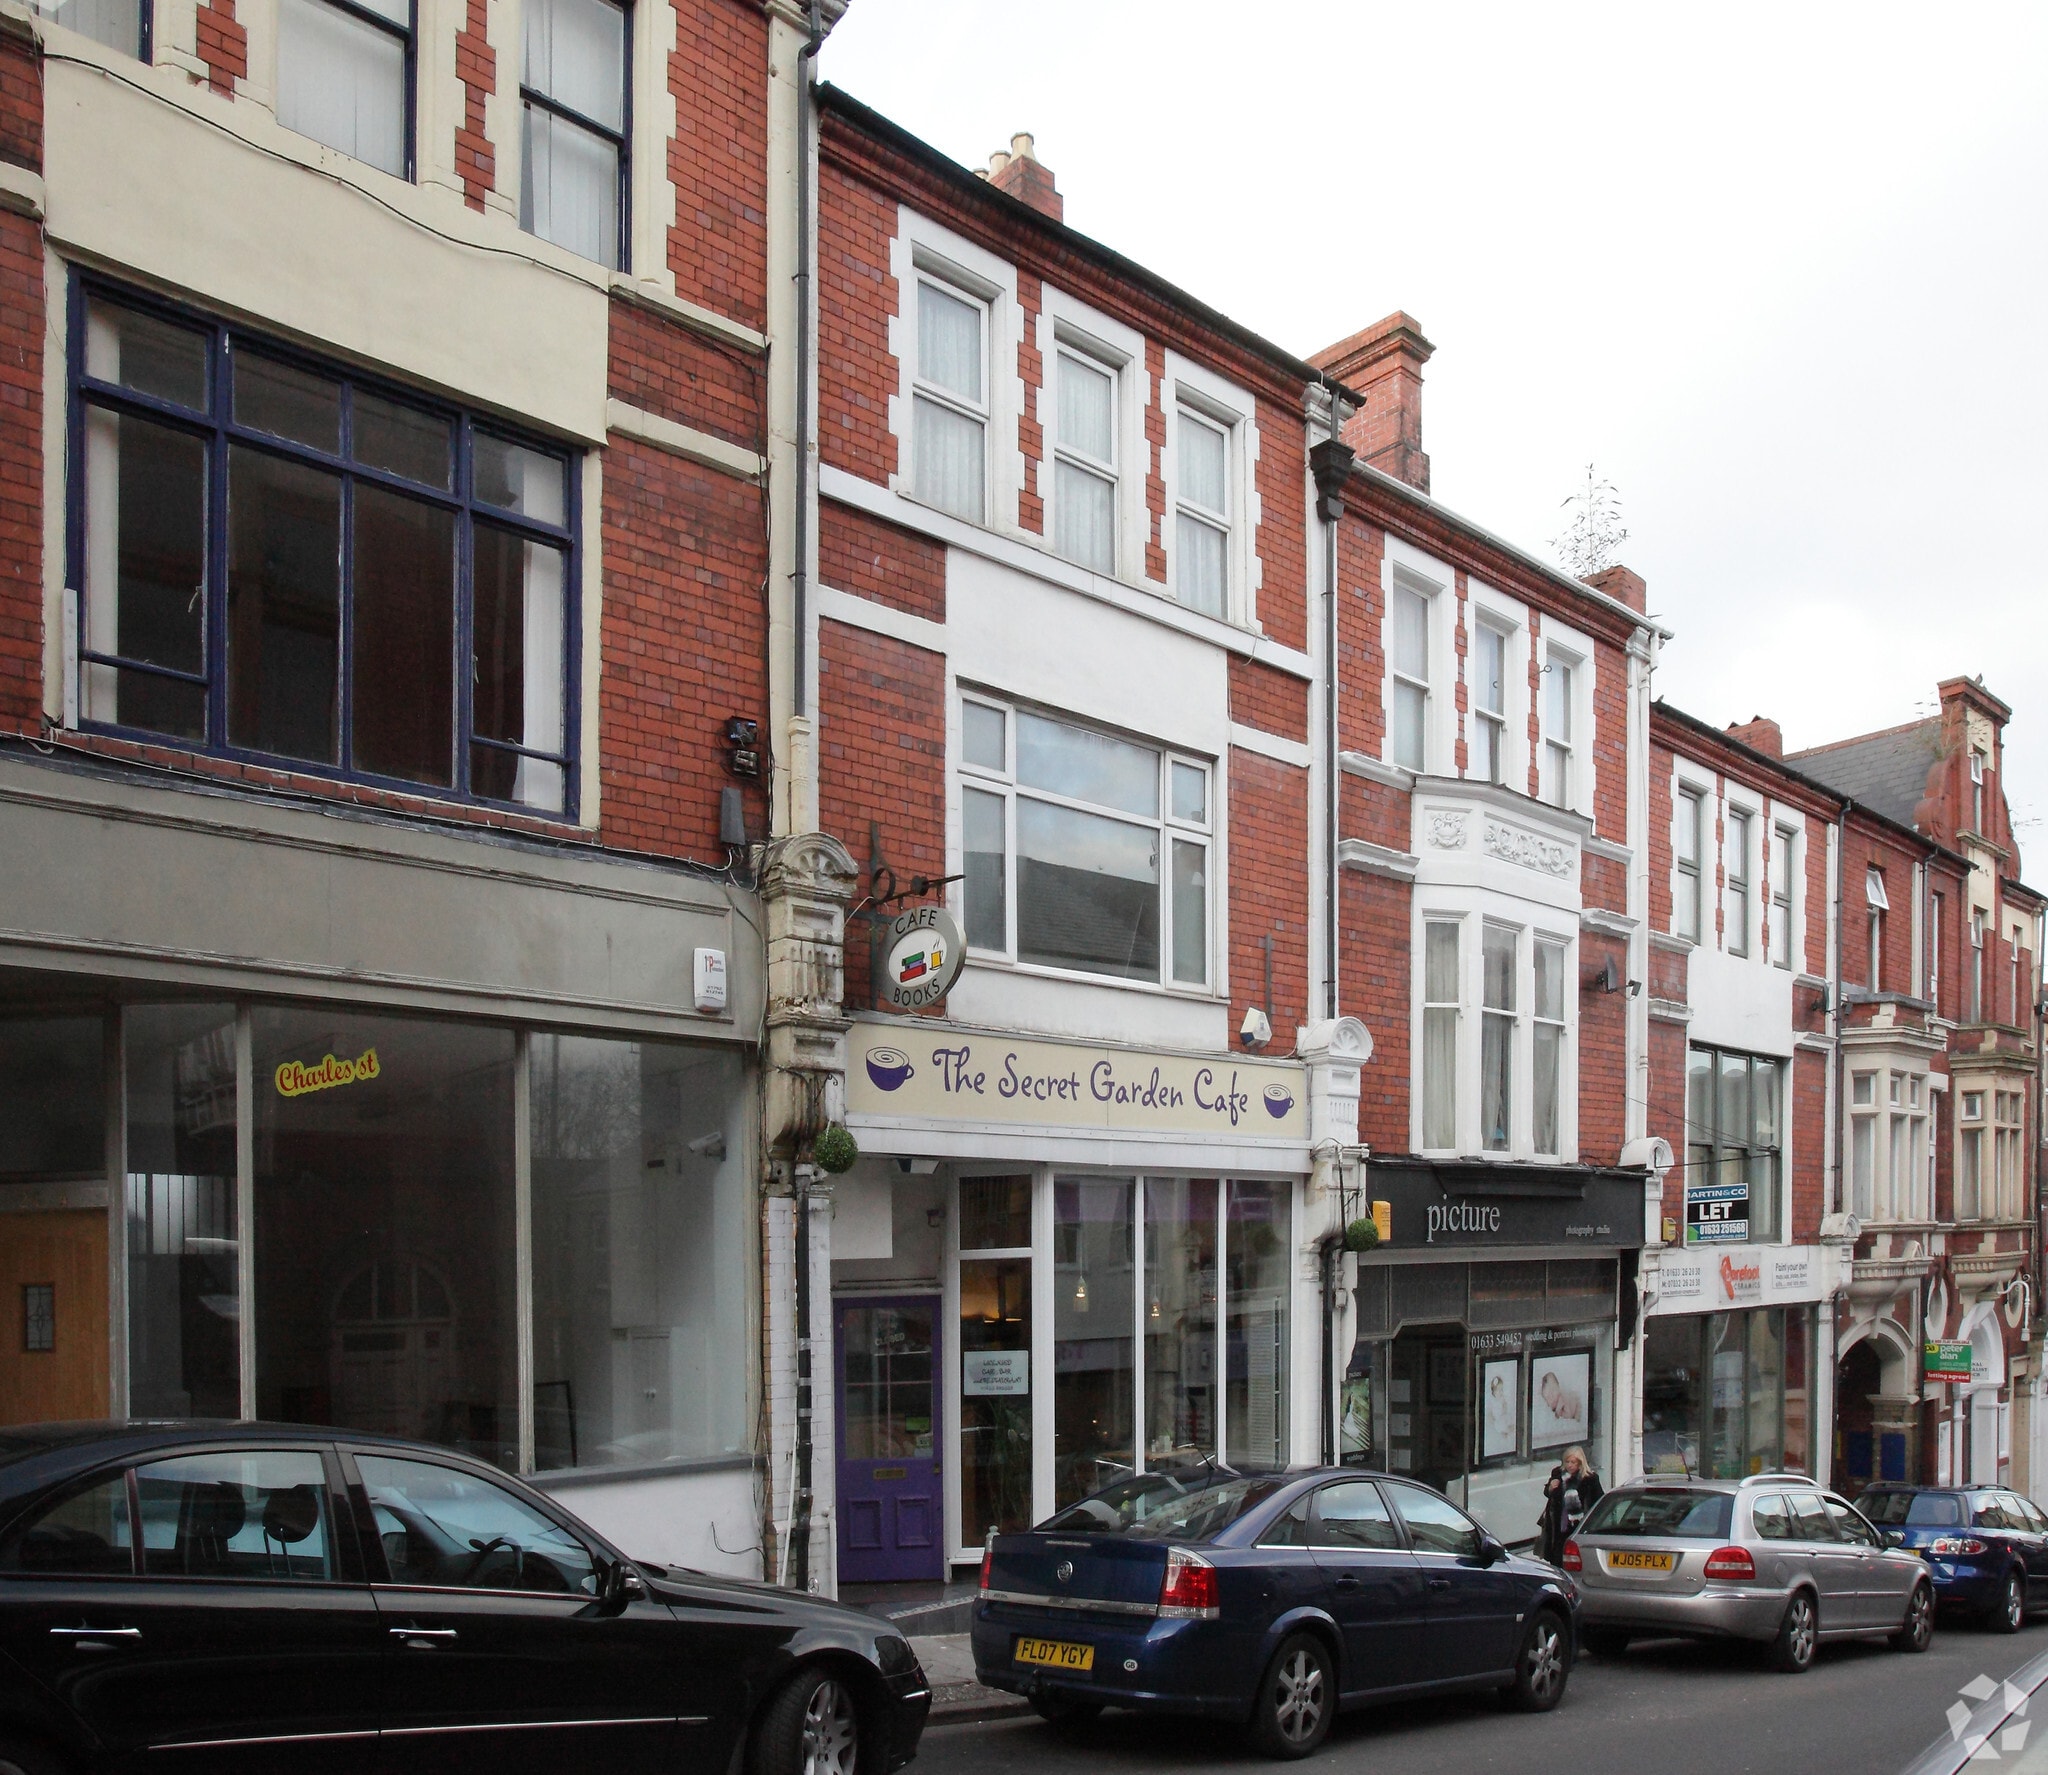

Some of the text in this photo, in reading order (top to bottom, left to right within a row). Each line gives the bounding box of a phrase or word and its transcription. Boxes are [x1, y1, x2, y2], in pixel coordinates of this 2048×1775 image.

[895, 908, 938, 934] CAFE
[893, 978, 940, 1006] BOOKS
[279, 1053, 376, 1092] Charles st
[932, 1046, 1249, 1126] The Secret Garden Cafe
[1426, 1193, 1501, 1243] picture
[1699, 1201, 1733, 1221] LET
[1699, 1224, 1720, 1235] 01633
[1471, 1332, 1522, 1349] 01633 549452
[1940, 1345, 1964, 1354] peter
[1940, 1351, 1958, 1360] alan
[1612, 1551, 1668, 1568] WJ05 PLX
[1020, 1640, 1089, 1666] FL07 YGY
[1125, 1660, 1137, 1670] GB
